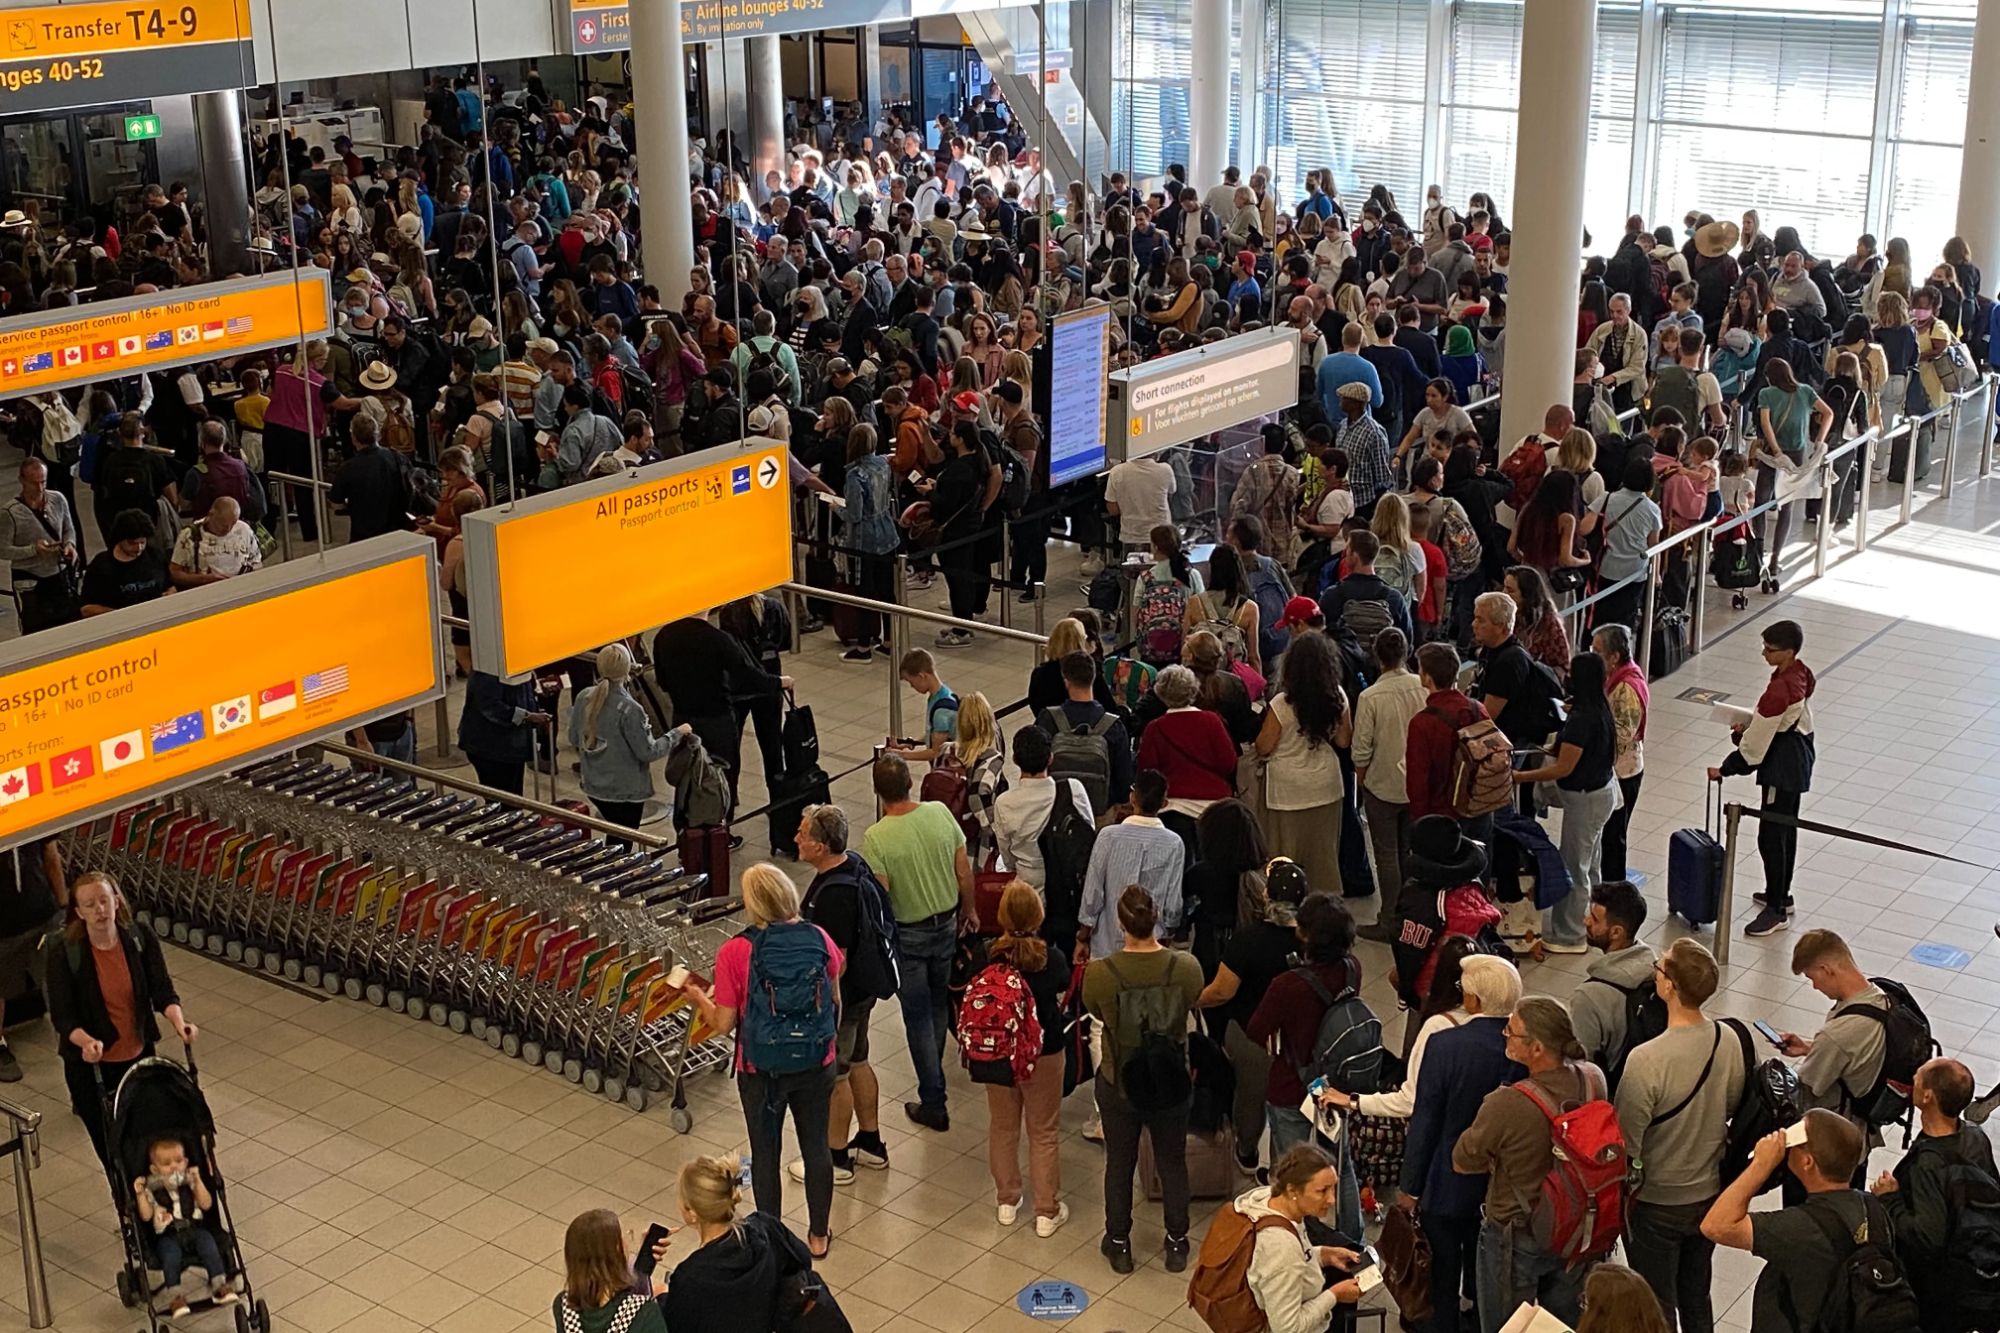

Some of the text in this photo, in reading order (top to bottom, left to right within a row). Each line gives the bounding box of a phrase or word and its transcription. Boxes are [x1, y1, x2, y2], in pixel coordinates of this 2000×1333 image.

[42, 6, 197, 41] Transfer T4-9
[742, 0, 789, 17] lounges
[602, 32, 629, 44] Eerste
[697, 24, 706, 37] By
[747, 18, 764, 30] only
[49, 59, 104, 81] 40-52
[40, 321, 89, 341] passport
[92, 313, 131, 329] control
[140, 309, 159, 320] 16+
[167, 305, 182, 315] No
[184, 301, 196, 313] ID
[199, 298, 221, 310] card
[1135, 374, 1205, 404] Short connection
[1154, 408, 1166, 419] For
[1167, 401, 1190, 415] flights
[1190, 388, 1222, 407] displayed
[1223, 387, 1232, 397] on
[1154, 418, 1170, 431] Voor
[1171, 409, 1199, 425] vluchten
[1200, 399, 1227, 419] getoond
[1227, 398, 1236, 408] op
[596, 497, 617, 520] All
[624, 478, 699, 515] passports
[620, 497, 700, 530] Passport control
[86, 648, 157, 686] control
[24, 709, 47, 724] 16+
[65, 699, 84, 712] No
[88, 691, 102, 705] ID
[106, 681, 134, 699] card
[27, 736, 64, 755] from:
[1399, 919, 1433, 949] BU
